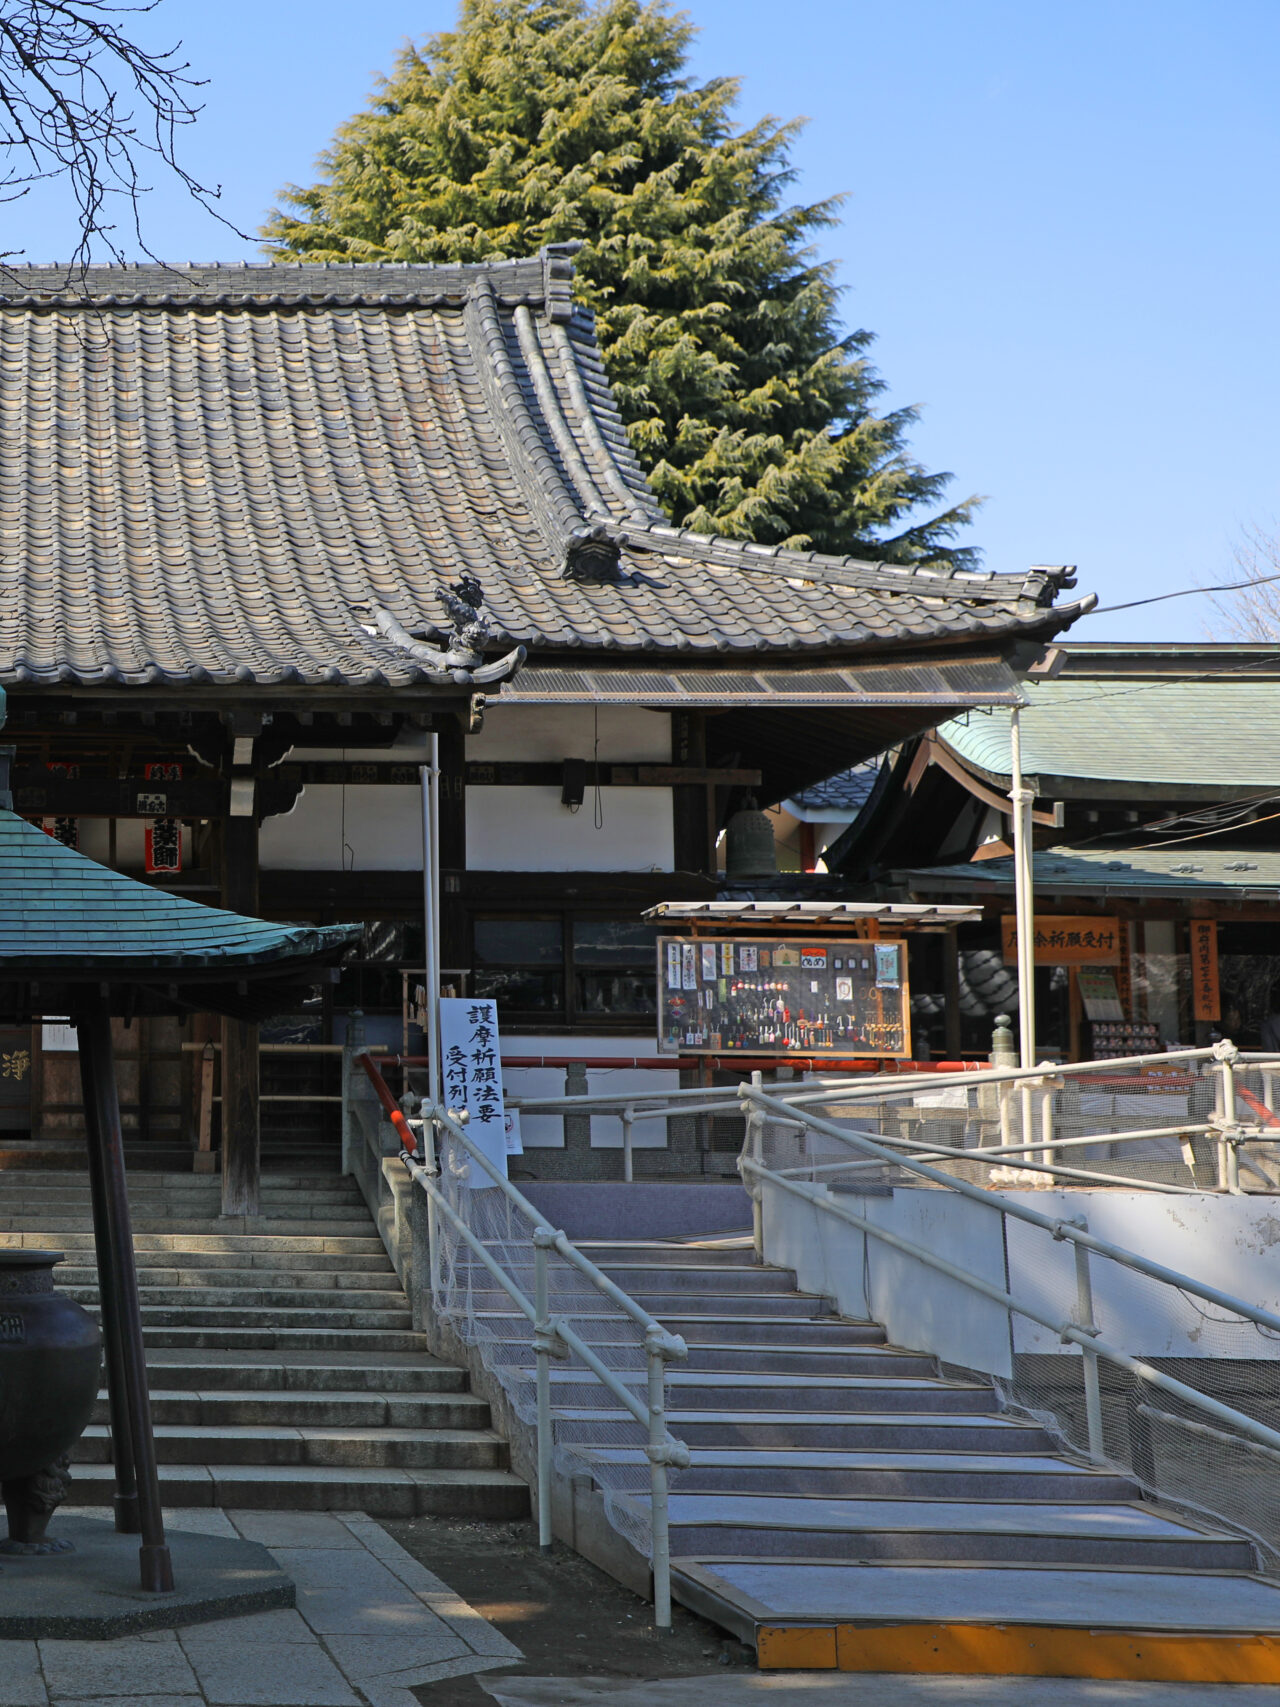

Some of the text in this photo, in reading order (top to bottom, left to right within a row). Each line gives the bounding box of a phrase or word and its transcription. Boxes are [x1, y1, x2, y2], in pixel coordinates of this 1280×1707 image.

[466, 1003, 503, 1124] 護摩祈願法要
